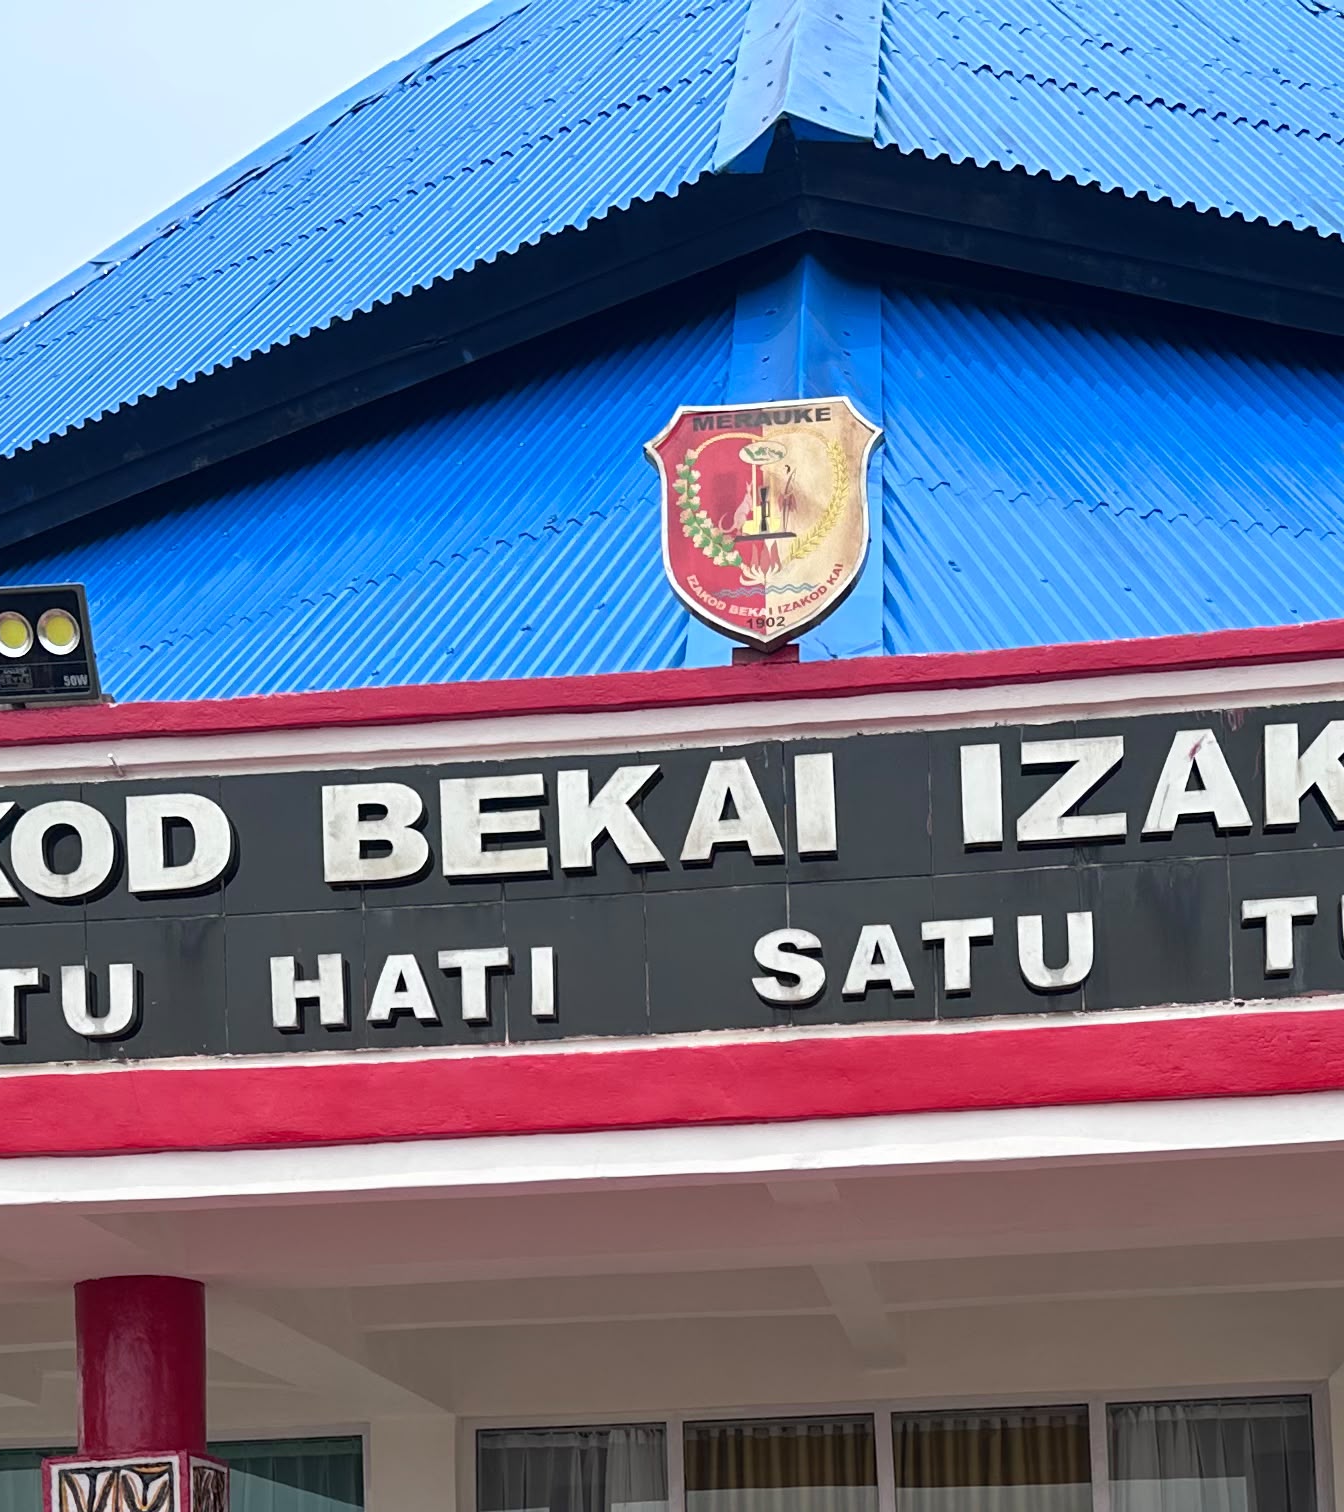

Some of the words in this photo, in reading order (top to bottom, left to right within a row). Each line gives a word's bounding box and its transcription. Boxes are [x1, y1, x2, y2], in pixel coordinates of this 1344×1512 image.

[693, 406, 831, 432] MERAUKE
[687, 574, 726, 611] IZAKOD
[728, 604, 773, 617] BEKAI
[777, 585, 828, 614] IZAKOD
[826, 563, 844, 586] KAI
[746, 616, 785, 629] 1902
[63, 674, 88, 687] 50W
[323, 752, 837, 886] BEKAI
[270, 946, 556, 1030] HATI
[753, 910, 1094, 1005] SATU
